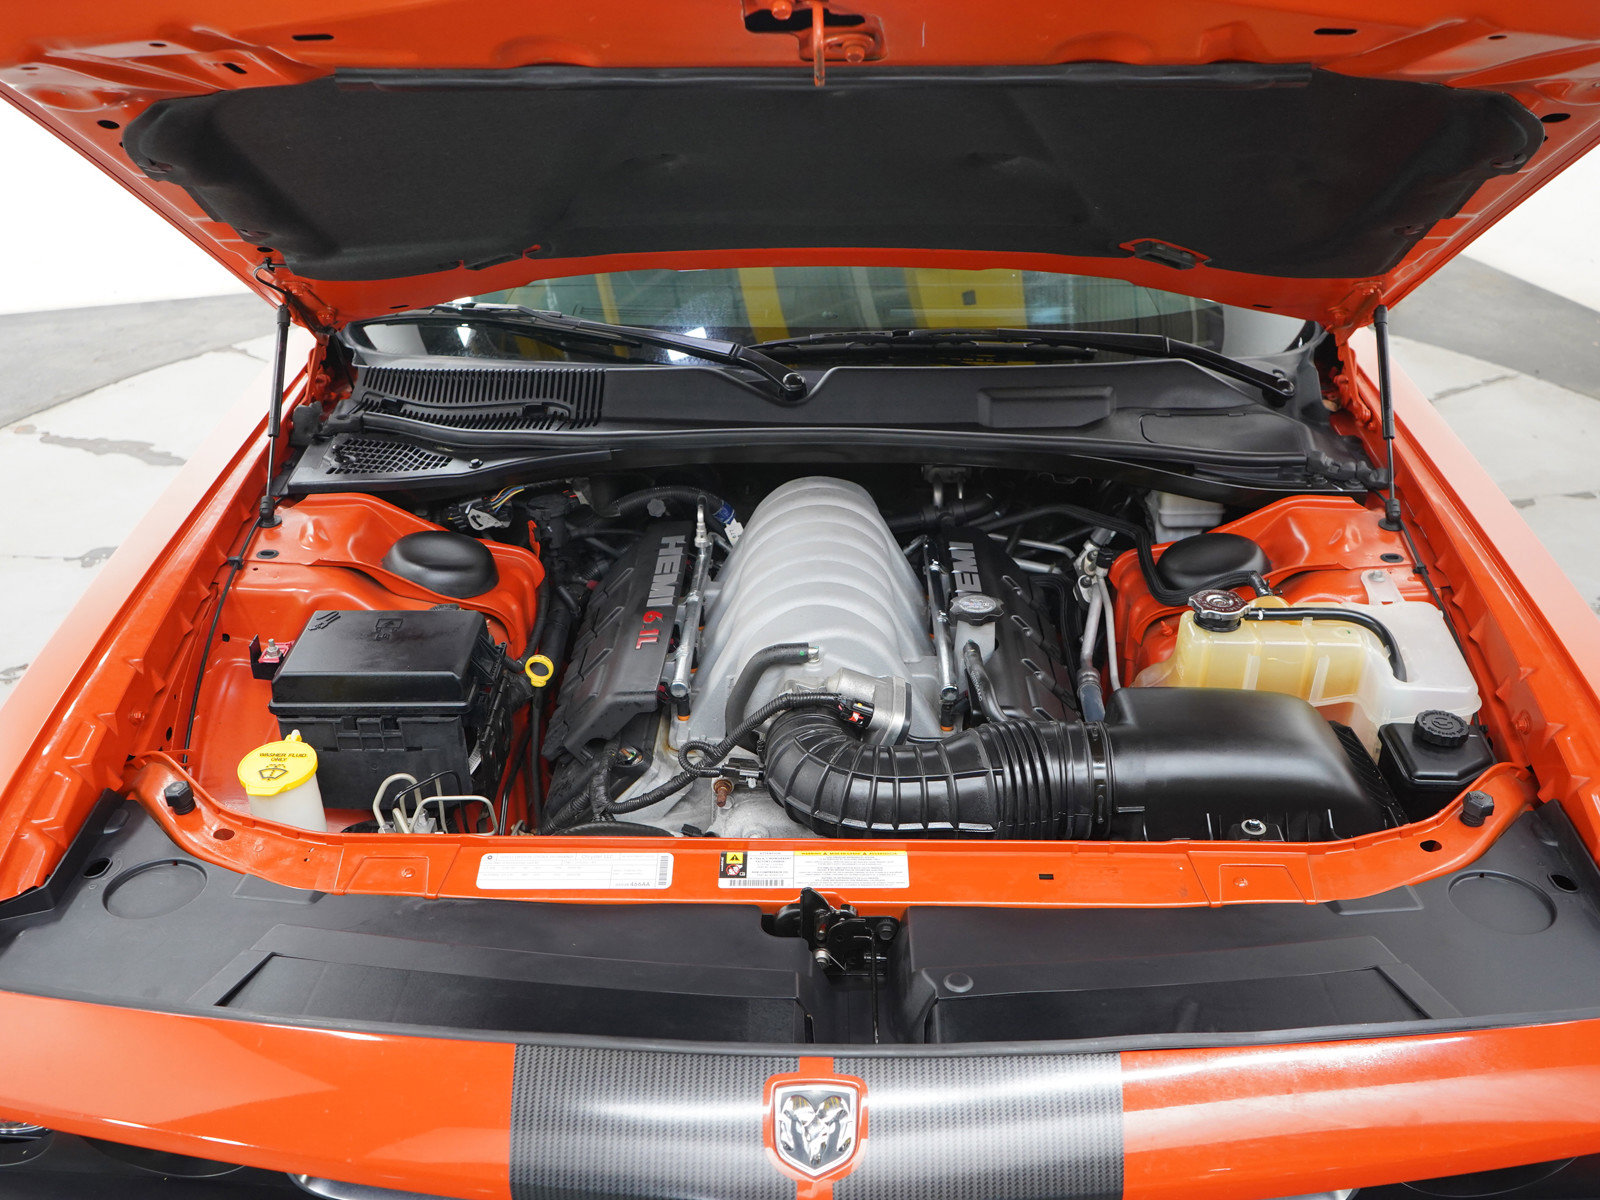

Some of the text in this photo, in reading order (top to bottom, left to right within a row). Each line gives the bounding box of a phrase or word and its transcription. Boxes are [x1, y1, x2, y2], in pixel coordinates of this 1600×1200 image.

[647, 534, 686, 607] HEMI
[949, 541, 982, 595] EMI
[635, 610, 663, 650] 6.1L
